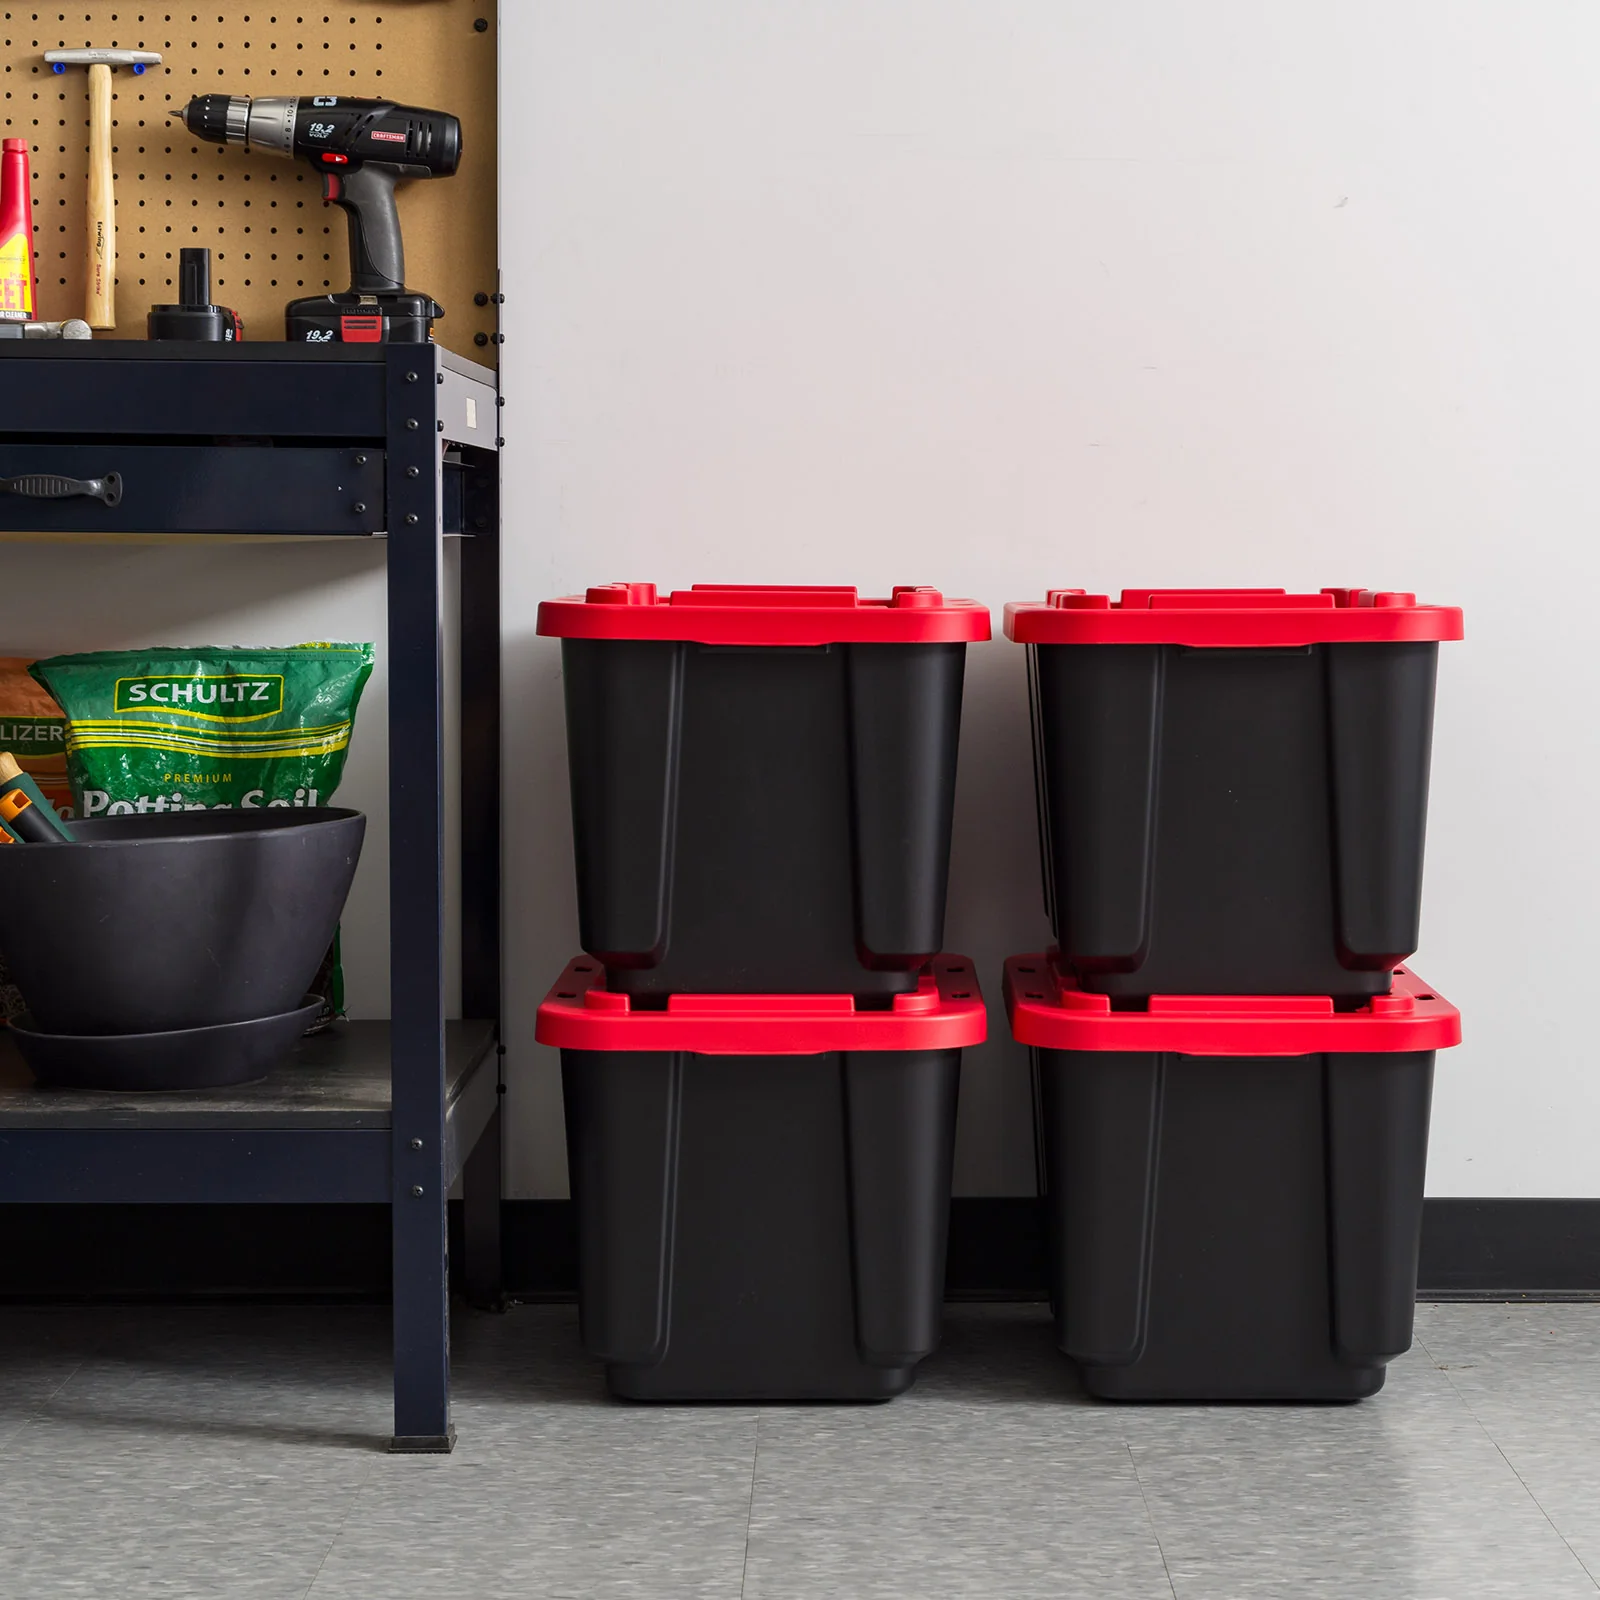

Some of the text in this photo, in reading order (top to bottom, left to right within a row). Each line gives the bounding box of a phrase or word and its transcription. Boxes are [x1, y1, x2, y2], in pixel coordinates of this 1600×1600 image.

[309, 122, 335, 133] 19.2
[0, 279, 27, 309] ET
[306, 330, 333, 340] 19.2
[129, 682, 269, 704] SCHULTZ
[0, 724, 63, 741] LIZER
[164, 773, 232, 783] PREMIUM
[83, 790, 232, 817] Potti
